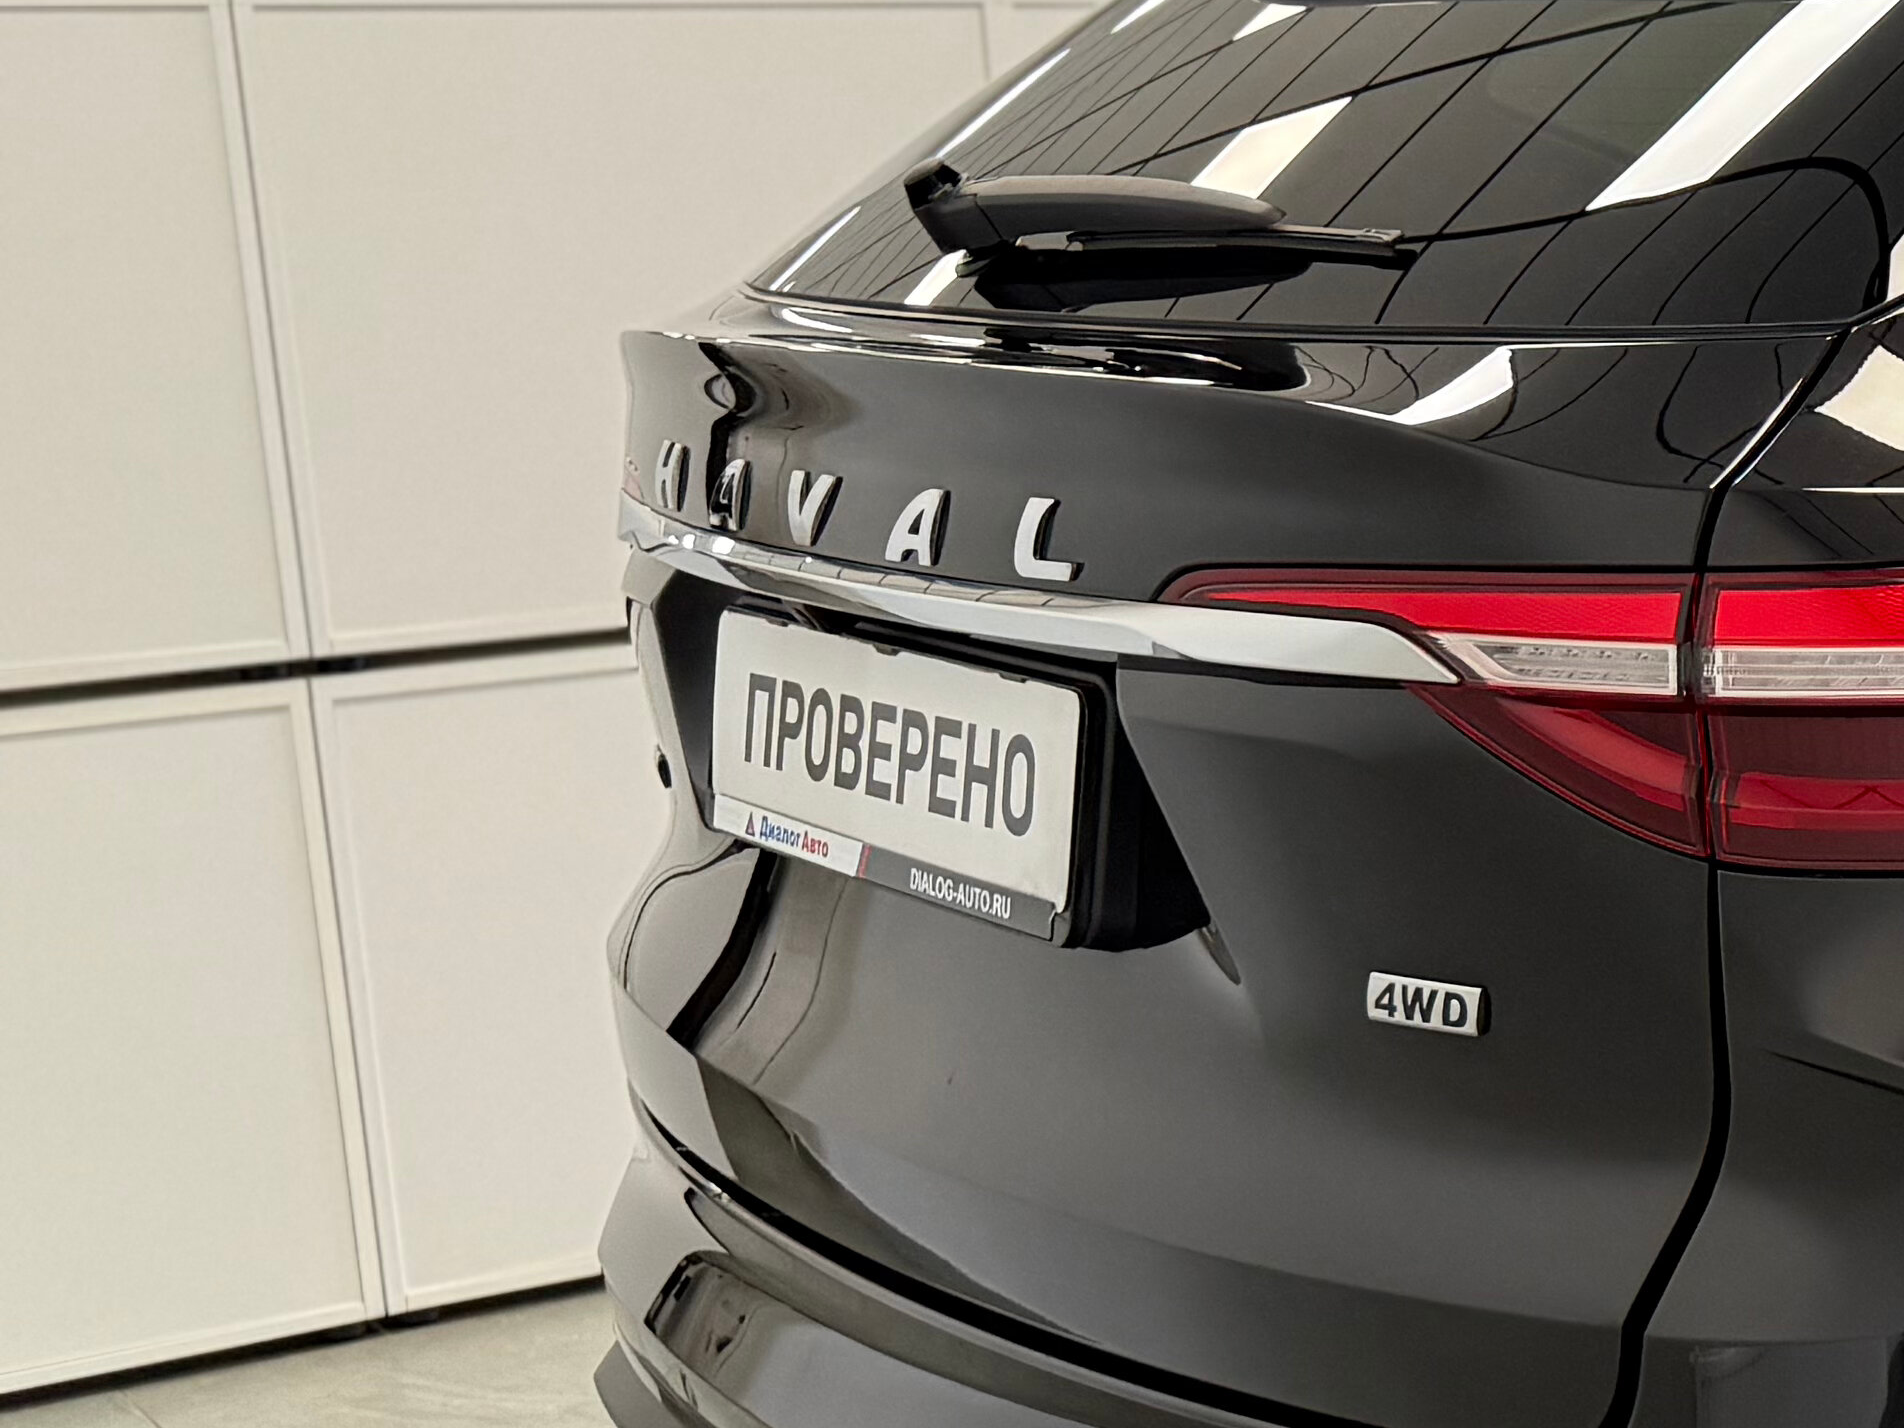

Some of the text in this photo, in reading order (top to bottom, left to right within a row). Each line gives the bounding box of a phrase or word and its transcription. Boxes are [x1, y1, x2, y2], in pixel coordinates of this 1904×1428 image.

[654, 439, 1083, 582] HAVAL
[743, 672, 1037, 837] ПРОВЕРЕНО
[801, 830, 829, 859] Авто
[910, 867, 1011, 919] DIALOG-AUTO.RU
[1374, 982, 1468, 1028] 4WD
